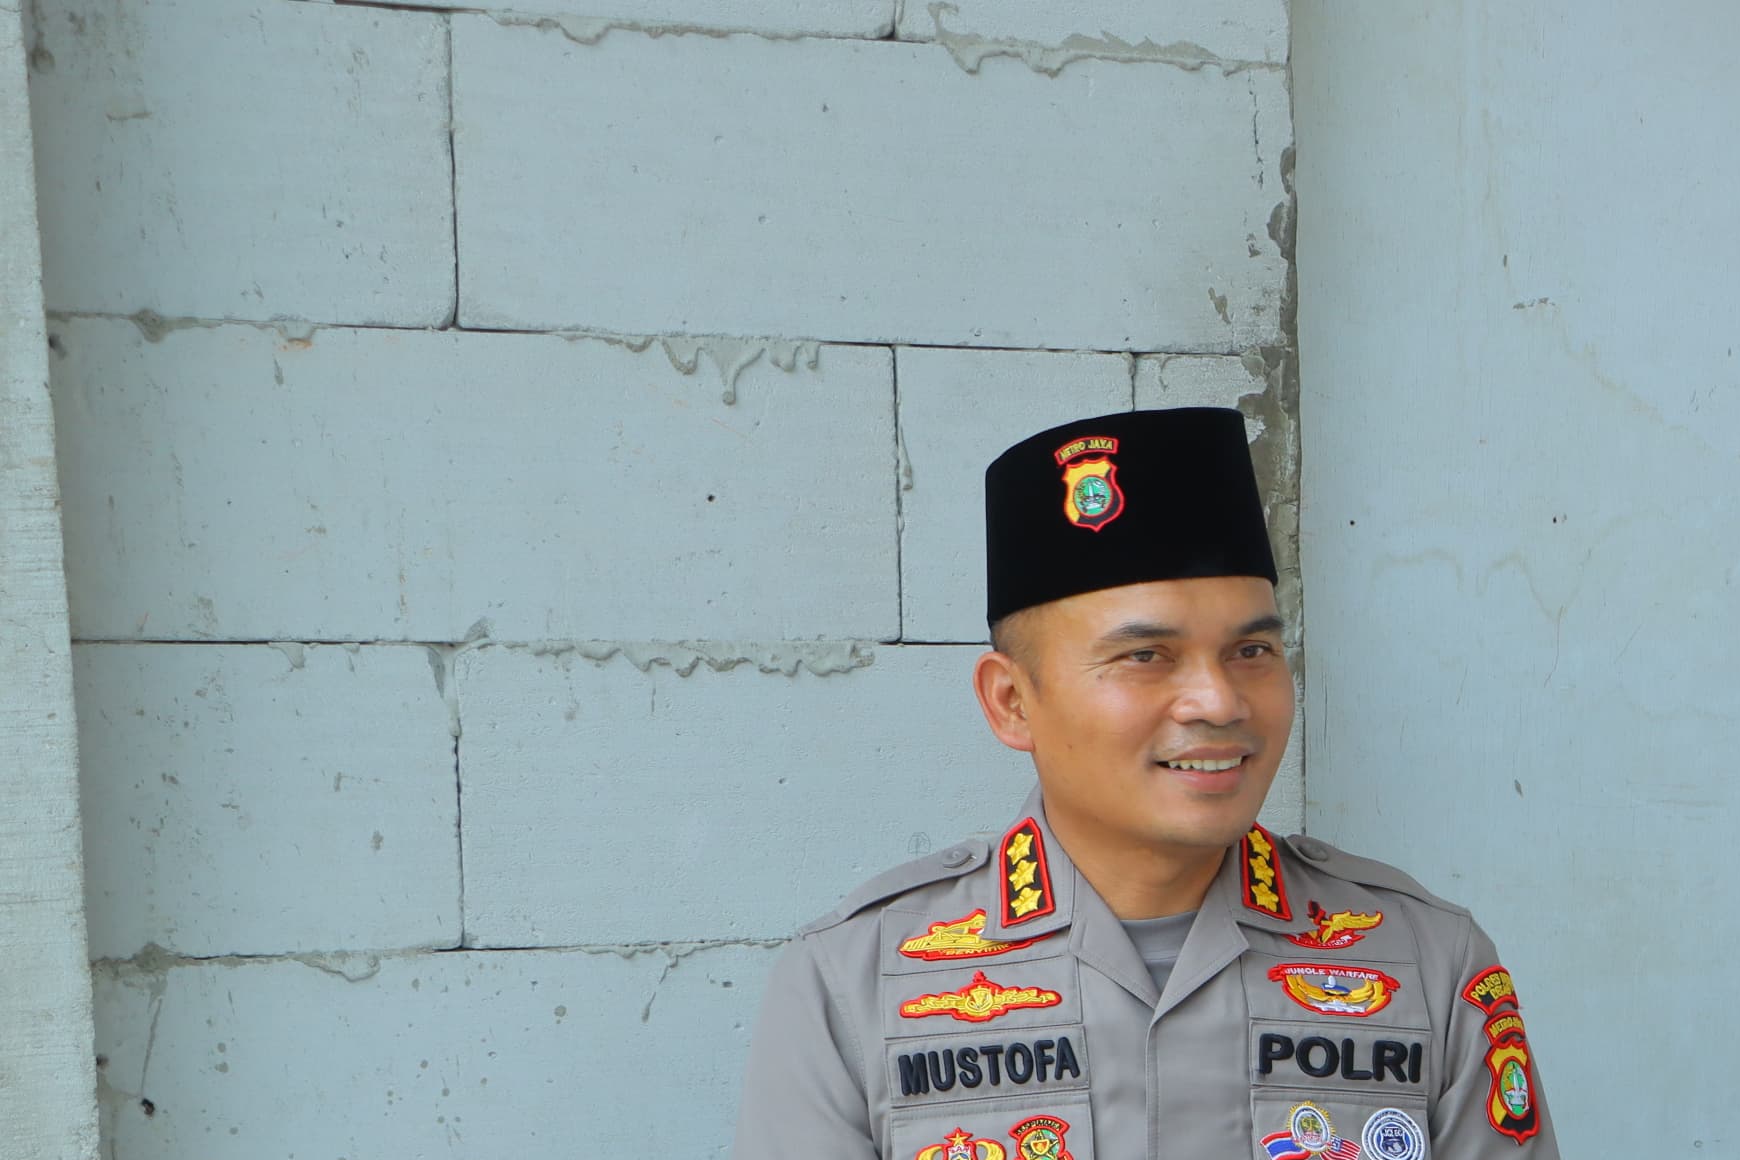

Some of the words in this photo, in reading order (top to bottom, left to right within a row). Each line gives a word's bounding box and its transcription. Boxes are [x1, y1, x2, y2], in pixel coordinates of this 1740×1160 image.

[1060, 442, 1085, 460] METRO
[1088, 439, 1112, 450] JAYA
[1285, 967, 1326, 977] JUNGLE
[1329, 969, 1379, 980] WARFARE
[898, 1036, 1080, 1096] MUSTOFA
[1259, 1033, 1422, 1084] POLRI
